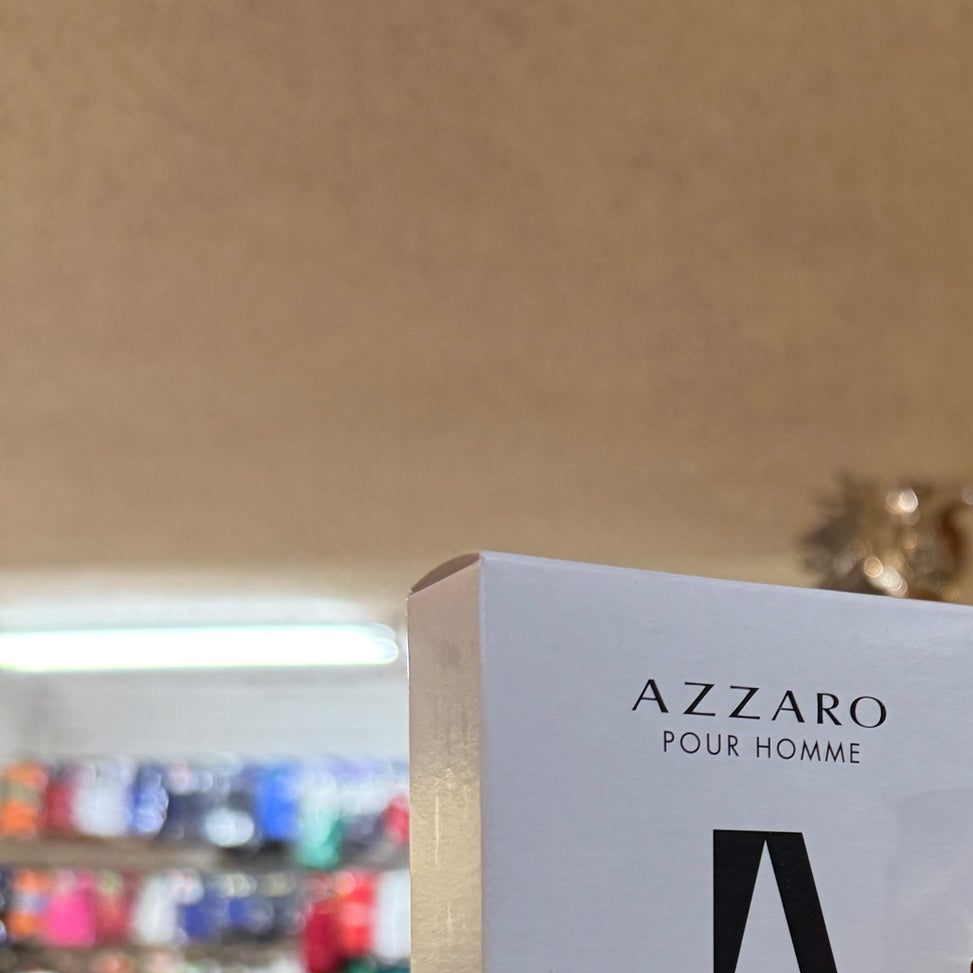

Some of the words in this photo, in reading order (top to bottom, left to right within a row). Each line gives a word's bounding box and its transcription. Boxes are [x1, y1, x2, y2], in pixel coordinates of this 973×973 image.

[632, 679, 887, 728] AZZARO
[663, 730, 739, 757] POUR
[756, 737, 860, 764] HOMME
